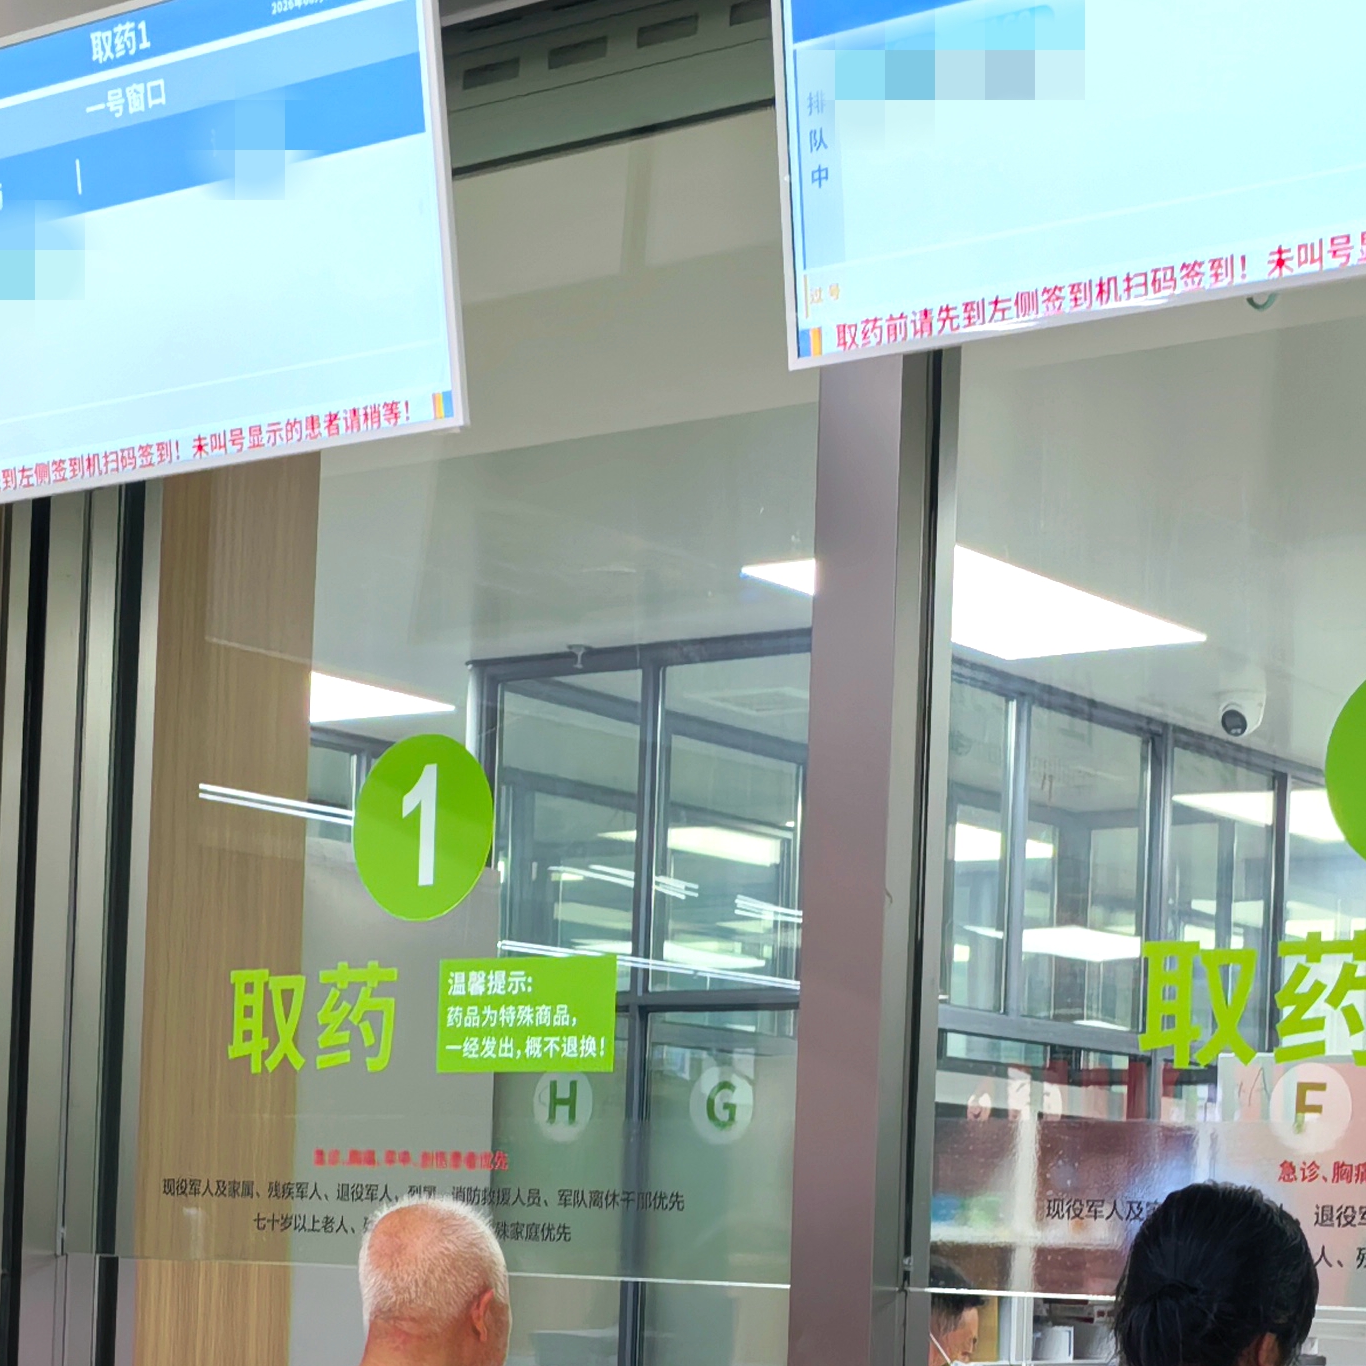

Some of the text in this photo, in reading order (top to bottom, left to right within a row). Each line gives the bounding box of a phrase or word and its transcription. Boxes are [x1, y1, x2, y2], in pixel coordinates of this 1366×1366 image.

[90, 20, 151, 64] 取药1
[86, 79, 166, 118] 一号窗口
[402, 763, 437, 886] 1
[227, 960, 398, 1074] 取药
[547, 1079, 578, 1125] H
[706, 1080, 737, 1131] G
[1294, 1082, 1327, 1134] F
